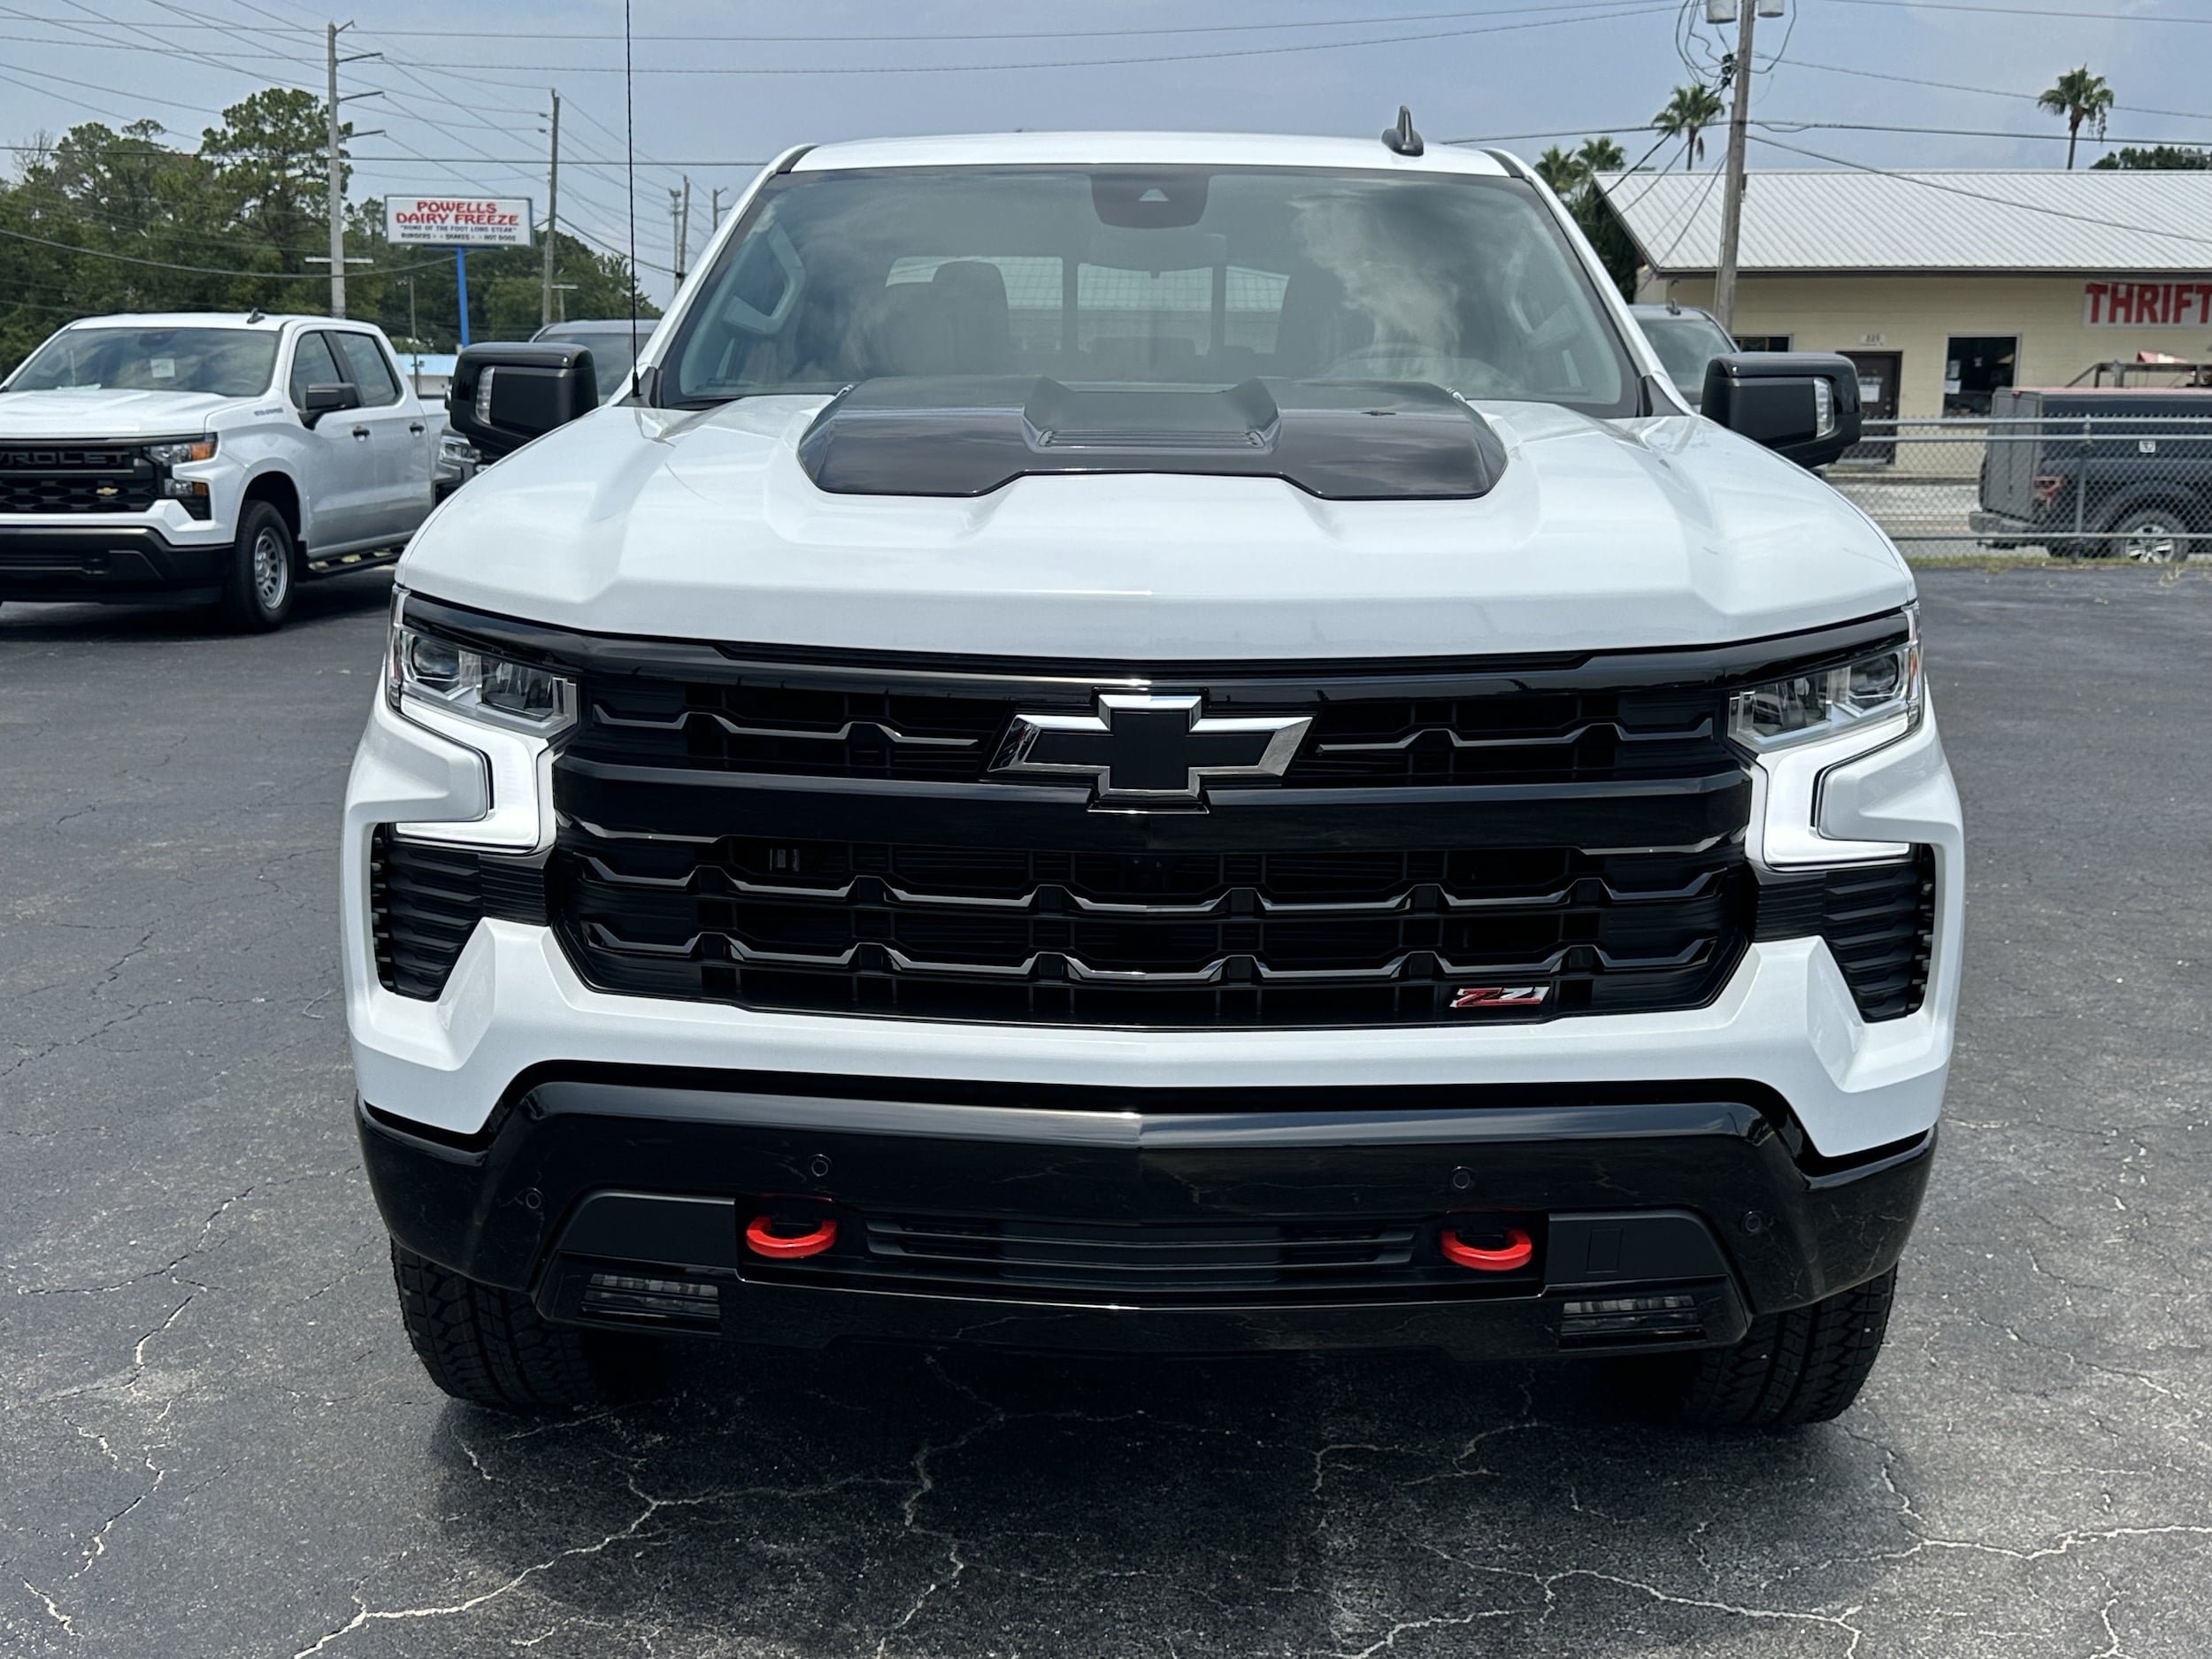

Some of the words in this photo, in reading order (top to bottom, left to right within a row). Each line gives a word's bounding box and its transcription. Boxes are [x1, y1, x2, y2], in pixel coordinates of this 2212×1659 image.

[417, 201, 497, 213] POWELLS
[396, 213, 449, 224] DAIRY
[454, 214, 519, 226] FREEZE
[2085, 283, 2212, 324] THRIFT
[1449, 986, 1550, 1008] Z71
